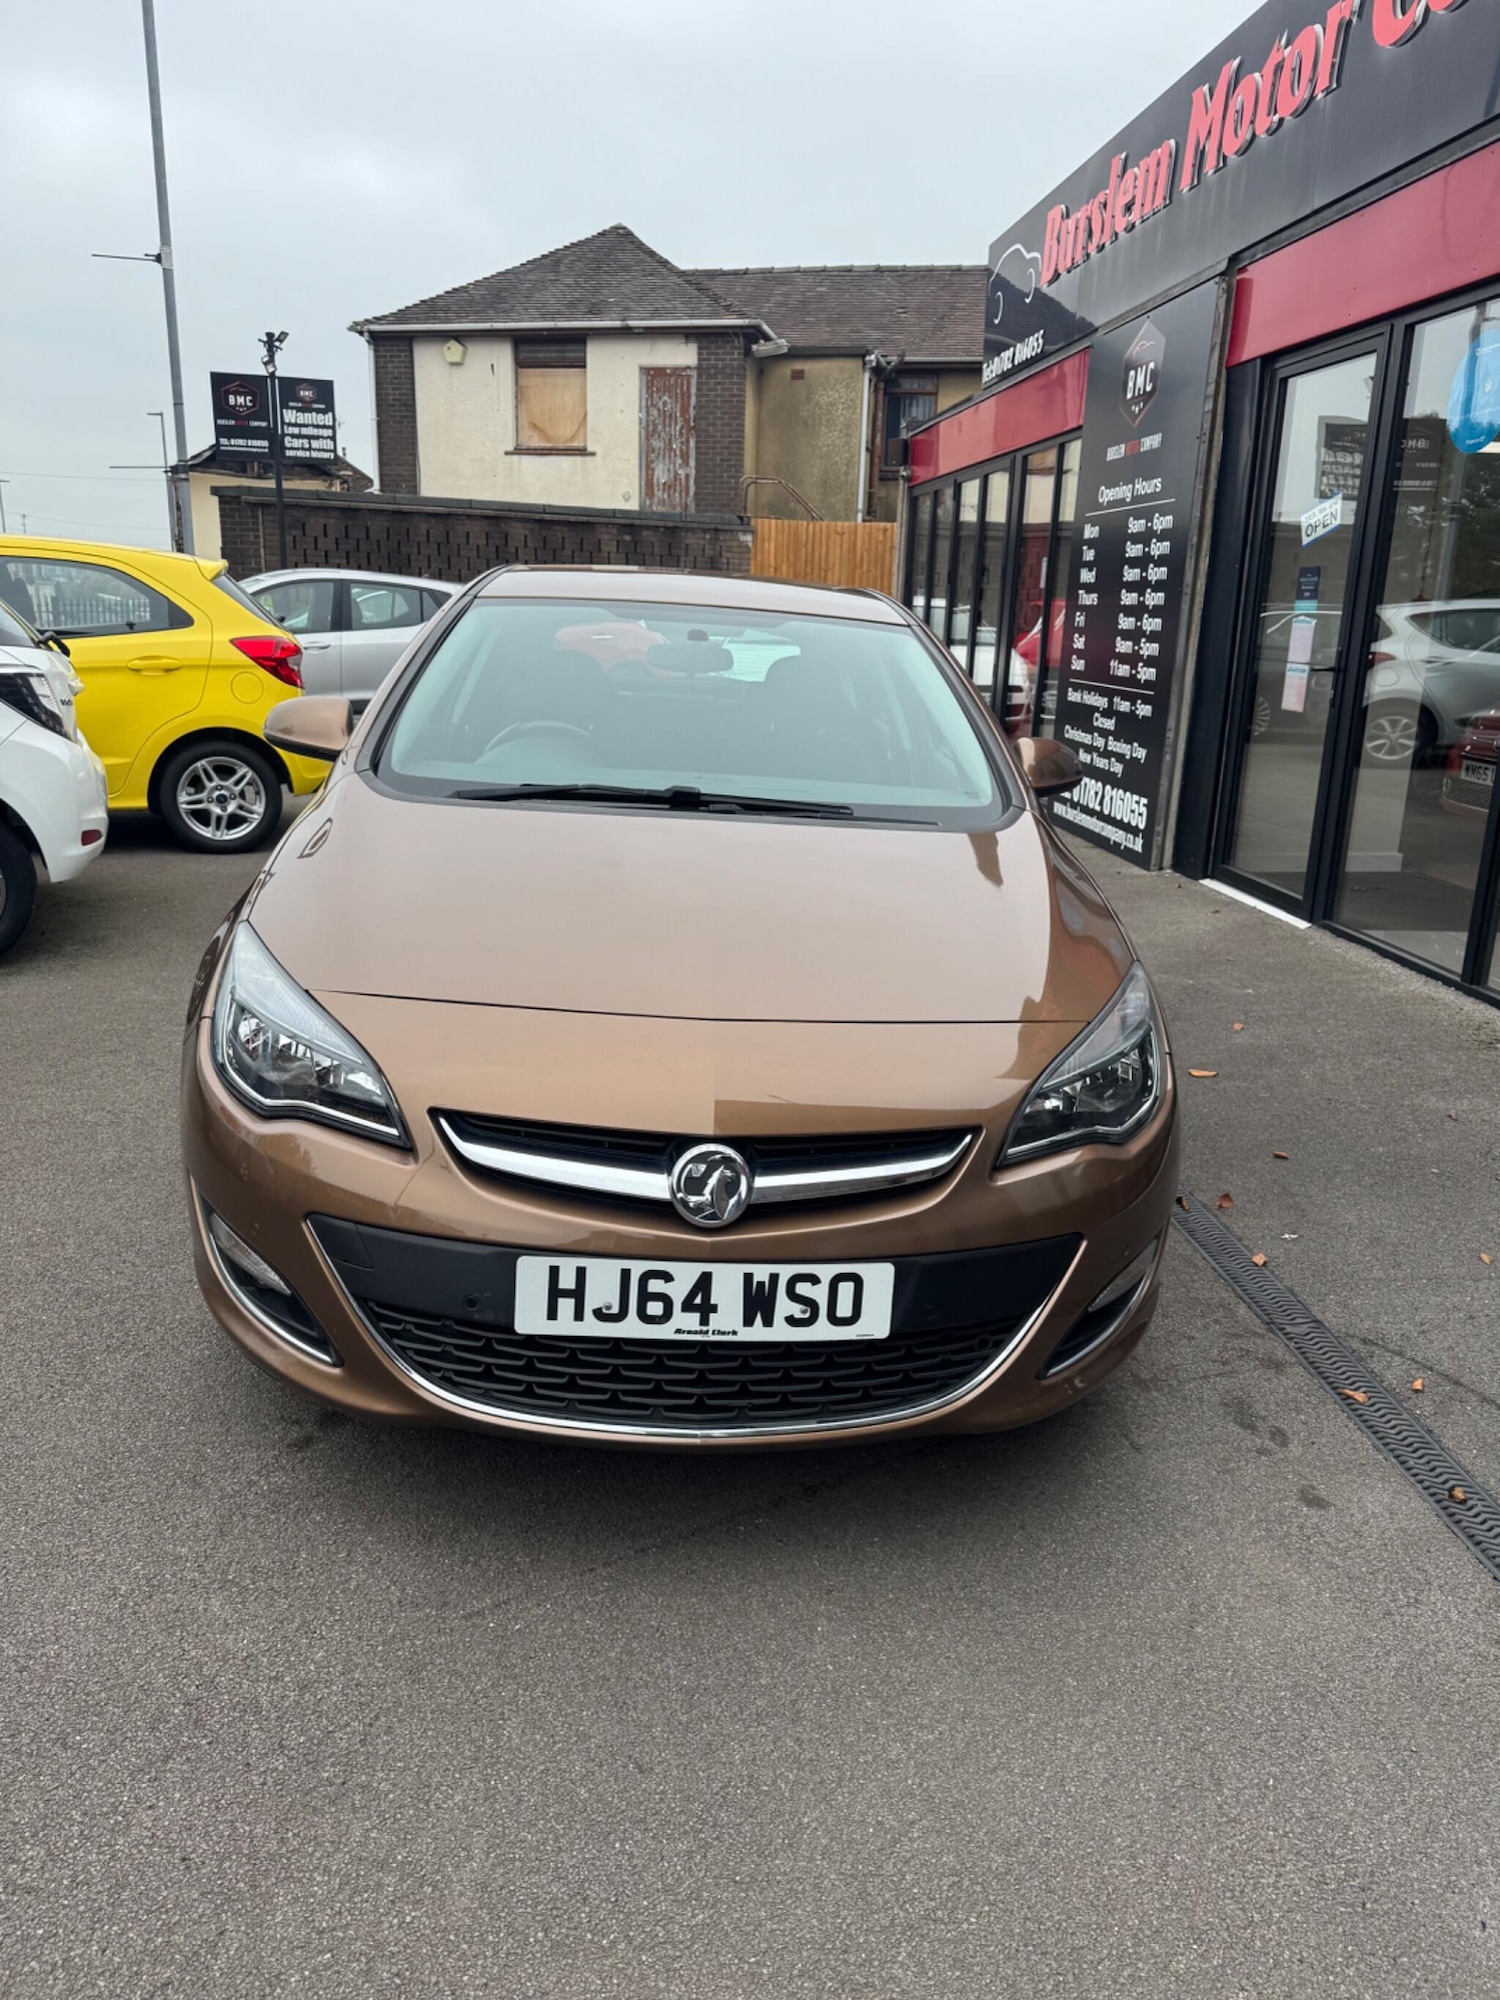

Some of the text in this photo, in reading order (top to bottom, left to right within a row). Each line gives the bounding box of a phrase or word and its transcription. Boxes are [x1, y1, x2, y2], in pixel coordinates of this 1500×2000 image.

[1040, 0, 1360, 288] Burslem Motor
[1126, 361, 1155, 400] BMC
[228, 394, 253, 406] BMC
[300, 390, 314, 398] BMC
[282, 408, 333, 426] Wanted
[284, 425, 333, 437] Low mileage
[284, 436, 334, 450] Cars with
[285, 449, 334, 460] service history
[1098, 477, 1162, 507] Opening Hours
[1083, 523, 1100, 540] Mon
[1127, 517, 1146, 534] 9am
[1153, 512, 1173, 534] 6pm
[1305, 508, 1338, 538] OPEN
[1082, 545, 1095, 561] Tue
[1125, 541, 1144, 558] 9am
[1150, 538, 1170, 560] 6pm
[1080, 567, 1097, 584] Wed
[1122, 564, 1141, 582] 9am
[1147, 563, 1168, 585] 6pm
[1077, 589, 1099, 606] Thurs
[1120, 588, 1139, 606] 9am
[1144, 588, 1165, 610] 6pm
[1075, 611, 1086, 628] Fri
[1118, 612, 1136, 630] 9am
[1142, 613, 1162, 635] 6pm
[1072, 633, 1086, 650] Sat
[1115, 636, 1133, 654] 9am
[1139, 637, 1160, 660] 5pm
[1070, 654, 1086, 671] Sun
[1109, 659, 1131, 678] 11am
[1136, 662, 1157, 684] 5pm
[1067, 687, 1082, 703] Bank
[1082, 689, 1109, 711] Holidays
[1113, 696, 1131, 713] 11am
[1135, 699, 1153, 719] 5pm
[1093, 712, 1116, 731] Closed
[1064, 724, 1148, 764] Christmas Day Boxing Day
[1079, 747, 1092, 765] New
[1110, 757, 1124, 778] Day
[1103, 784, 1148, 830] 816055
[546, 1264, 865, 1329] HJ64 WSO
[673, 1328, 710, 1337] Arnold
[711, 1329, 738, 1337] Clark
